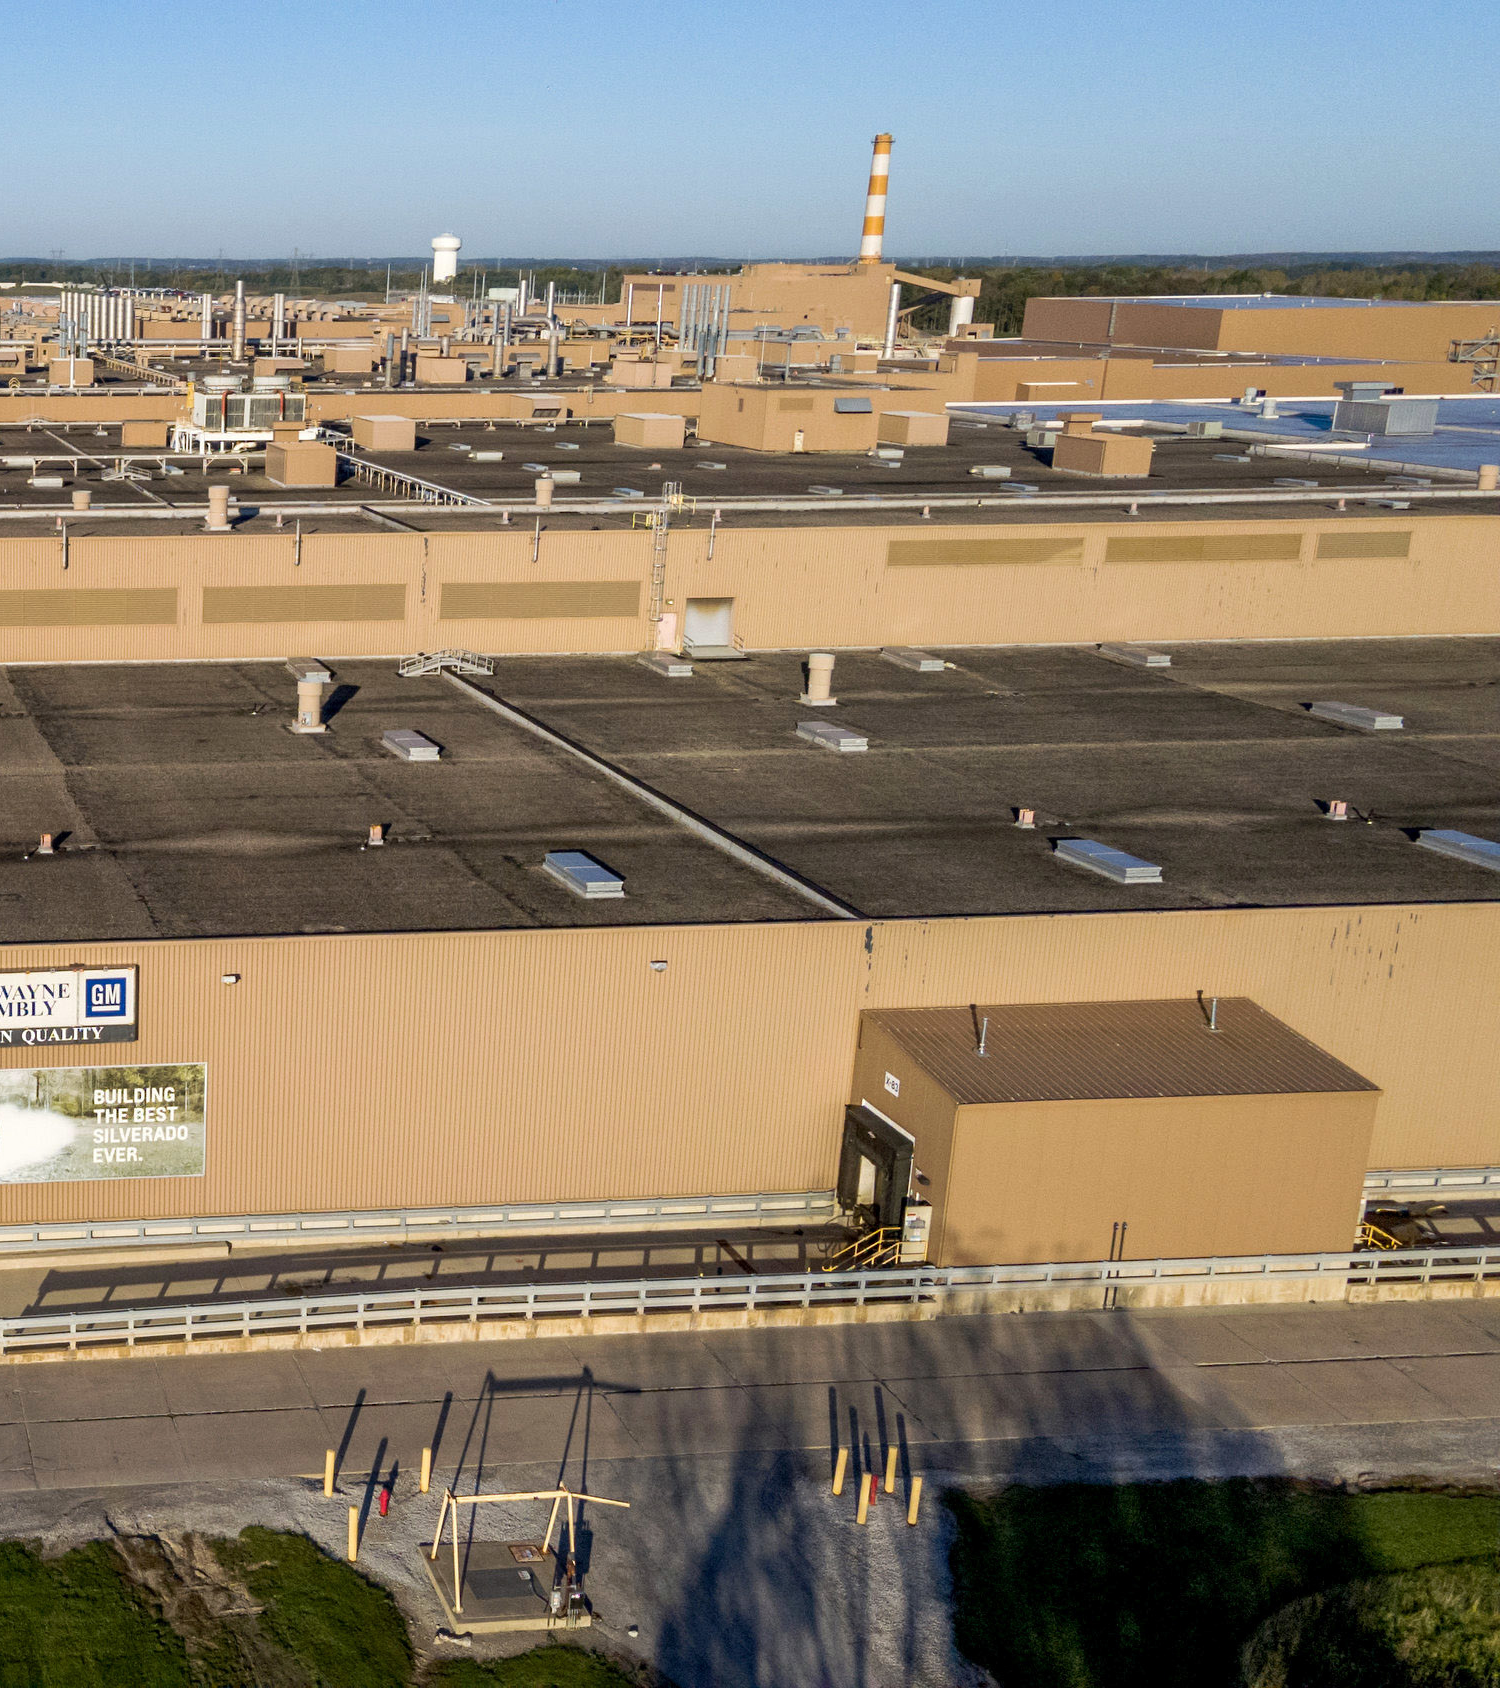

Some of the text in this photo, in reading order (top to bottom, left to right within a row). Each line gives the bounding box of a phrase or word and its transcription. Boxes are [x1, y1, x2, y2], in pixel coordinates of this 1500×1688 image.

[91, 983, 121, 1006] GM
[21, 1026, 105, 1046] QUALITY
[93, 1086, 176, 1106] BUILDING
[93, 1105, 178, 1125] THE BEST
[93, 1124, 189, 1144] SILVERADO
[93, 1146, 143, 1164] EVER.
